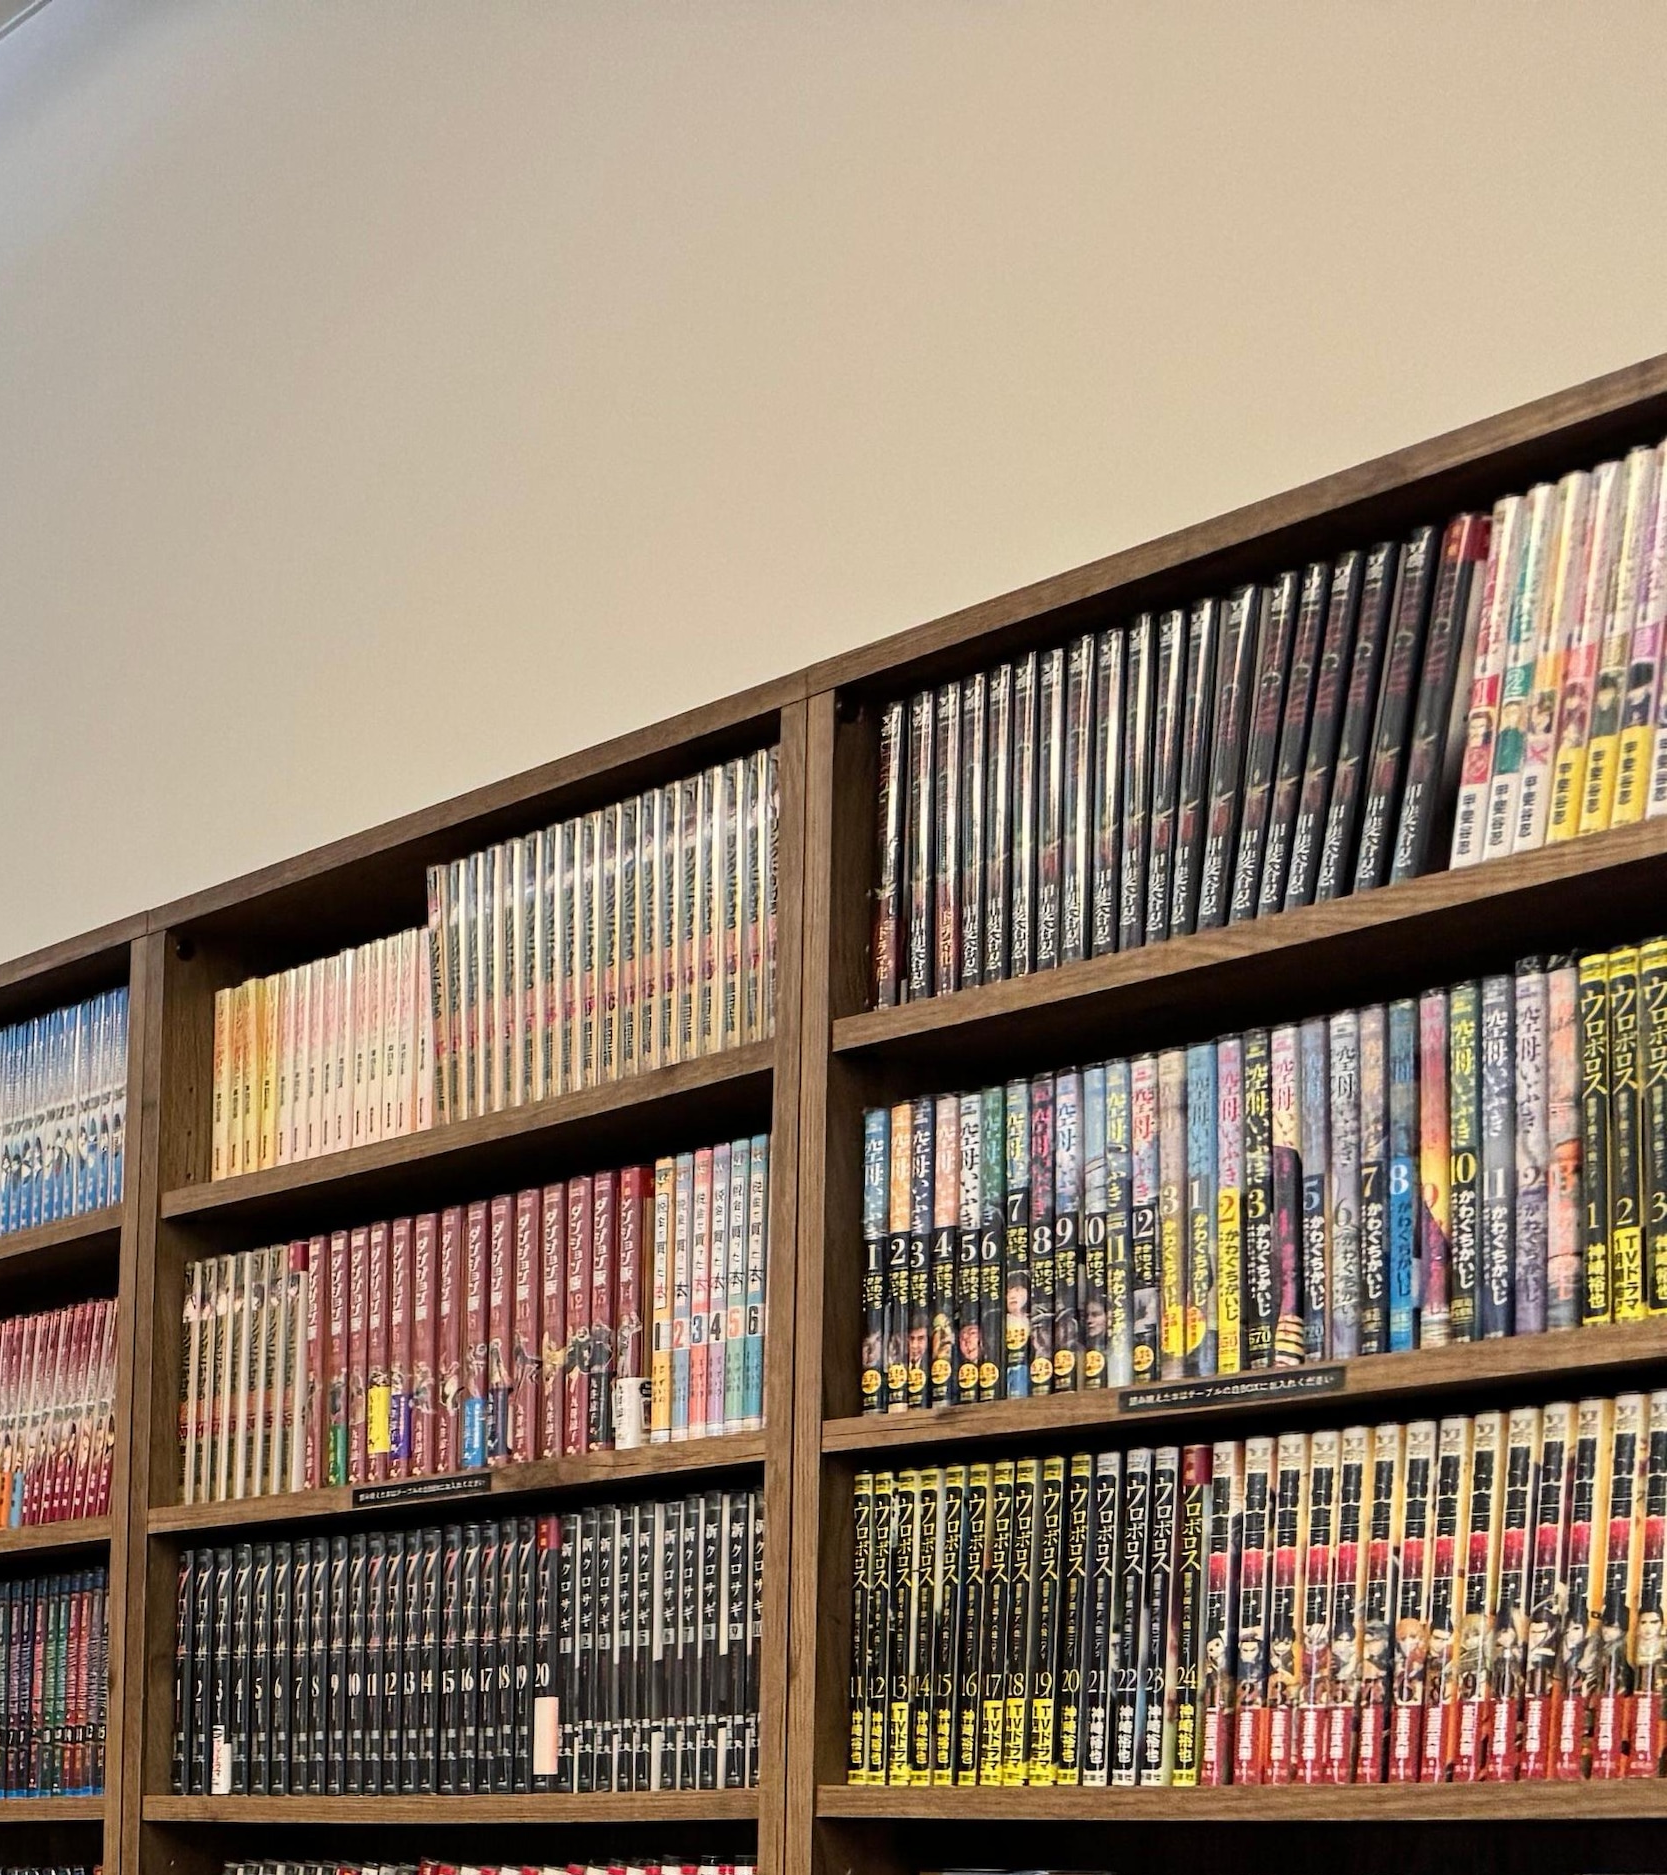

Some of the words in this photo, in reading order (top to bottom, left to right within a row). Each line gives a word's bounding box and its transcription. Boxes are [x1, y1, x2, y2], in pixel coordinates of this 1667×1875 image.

[1580, 990, 1607, 1099] ウロボロス
[1610, 984, 1638, 1094] ウロボロス
[1391, 1164, 1409, 1195] 8
[1451, 1152, 1475, 1182] 10
[1304, 1180, 1319, 1210] 5
[1362, 1166, 1378, 1197] 7
[1008, 1193, 1024, 1221] 7
[1250, 1189, 1265, 1219] 3
[1587, 1203, 1598, 1229] 1
[1615, 1197, 1632, 1225] 2
[934, 1232, 952, 1257] 4
[1032, 1226, 1052, 1254] 8
[1056, 1218, 1073, 1246] 9
[868, 1244, 878, 1269] 1
[890, 1239, 905, 1264] 2
[911, 1242, 925, 1267] 3
[961, 1235, 977, 1261] 5
[982, 1234, 997, 1260] 6
[710, 1313, 721, 1340] 4
[729, 1308, 740, 1337] 5
[749, 1306, 758, 1334] 6
[990, 1491, 1011, 1584] ウロボロス
[1040, 1487, 1060, 1581] ウロボロス
[1067, 1483, 1088, 1578] ウロボロス
[1093, 1482, 1115, 1578] ウロボロス
[1123, 1479, 1145, 1575] ウロボロス
[1151, 1479, 1173, 1573] ウロボロス
[874, 1501, 889, 1589] ウロボロス
[581, 1537, 594, 1628] 新クロサギ
[639, 1531, 651, 1623] 新クロサギ
[703, 1522, 718, 1618] 新クロサギ
[730, 1522, 745, 1617] 新クロサギ
[255, 1678, 262, 1699] 5
[275, 1677, 282, 1699] 6
[348, 1673, 360, 1695] 10
[385, 1672, 397, 1695] 12
[461, 1667, 474, 1691] 16
[480, 1667, 493, 1691] 17
[892, 1674, 907, 1698] 13
[986, 1674, 1002, 1696] 17
[1035, 1672, 1052, 1696] 19
[1062, 1669, 1080, 1692] 20
[1087, 1670, 1106, 1694] 21
[1117, 1668, 1137, 1692] 22
[1145, 1668, 1164, 1692] 23
[1177, 1666, 1196, 1690] 24
